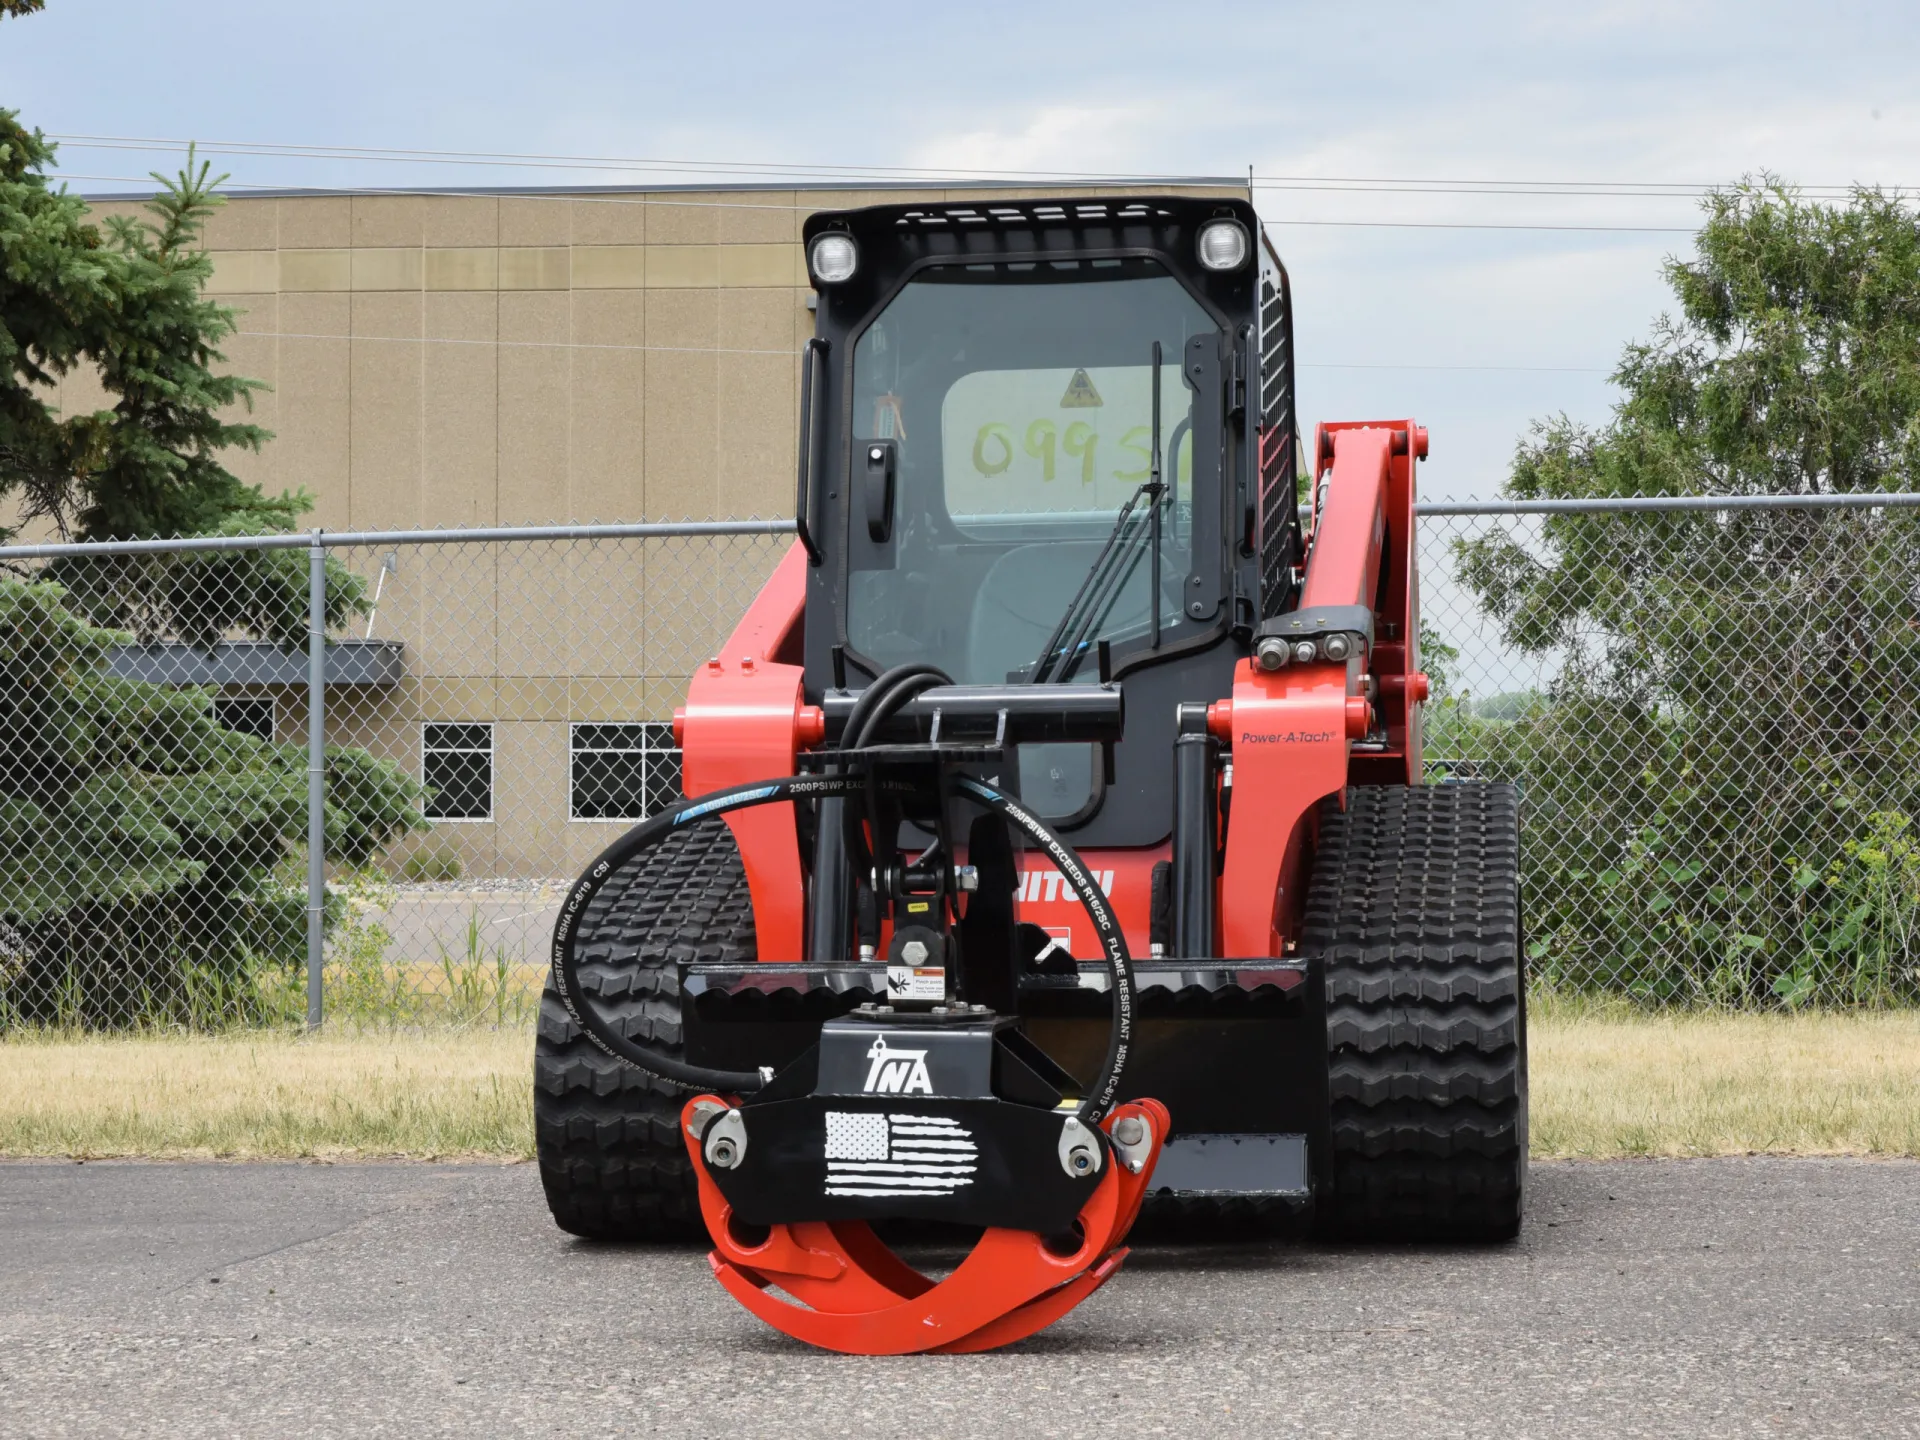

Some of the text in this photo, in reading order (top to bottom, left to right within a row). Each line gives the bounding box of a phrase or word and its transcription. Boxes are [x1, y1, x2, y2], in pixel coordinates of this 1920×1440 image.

[593, 861, 610, 878] CSI
[1049, 841, 1087, 887] EXCEEDS
[568, 881, 592, 913] IC-8/19
[1083, 886, 1111, 931] R16/2SC
[557, 913, 573, 942] MSHA
[555, 944, 568, 997] RESISTANT
[1108, 937, 1126, 976] FLAME
[562, 997, 584, 1025] FLAME
[1118, 978, 1130, 1040] RESISTANT
[1112, 1045, 1128, 1074] MSHA
[1100, 1075, 1119, 1106] IC-8/19
[1089, 1111, 1101, 1123] CS
